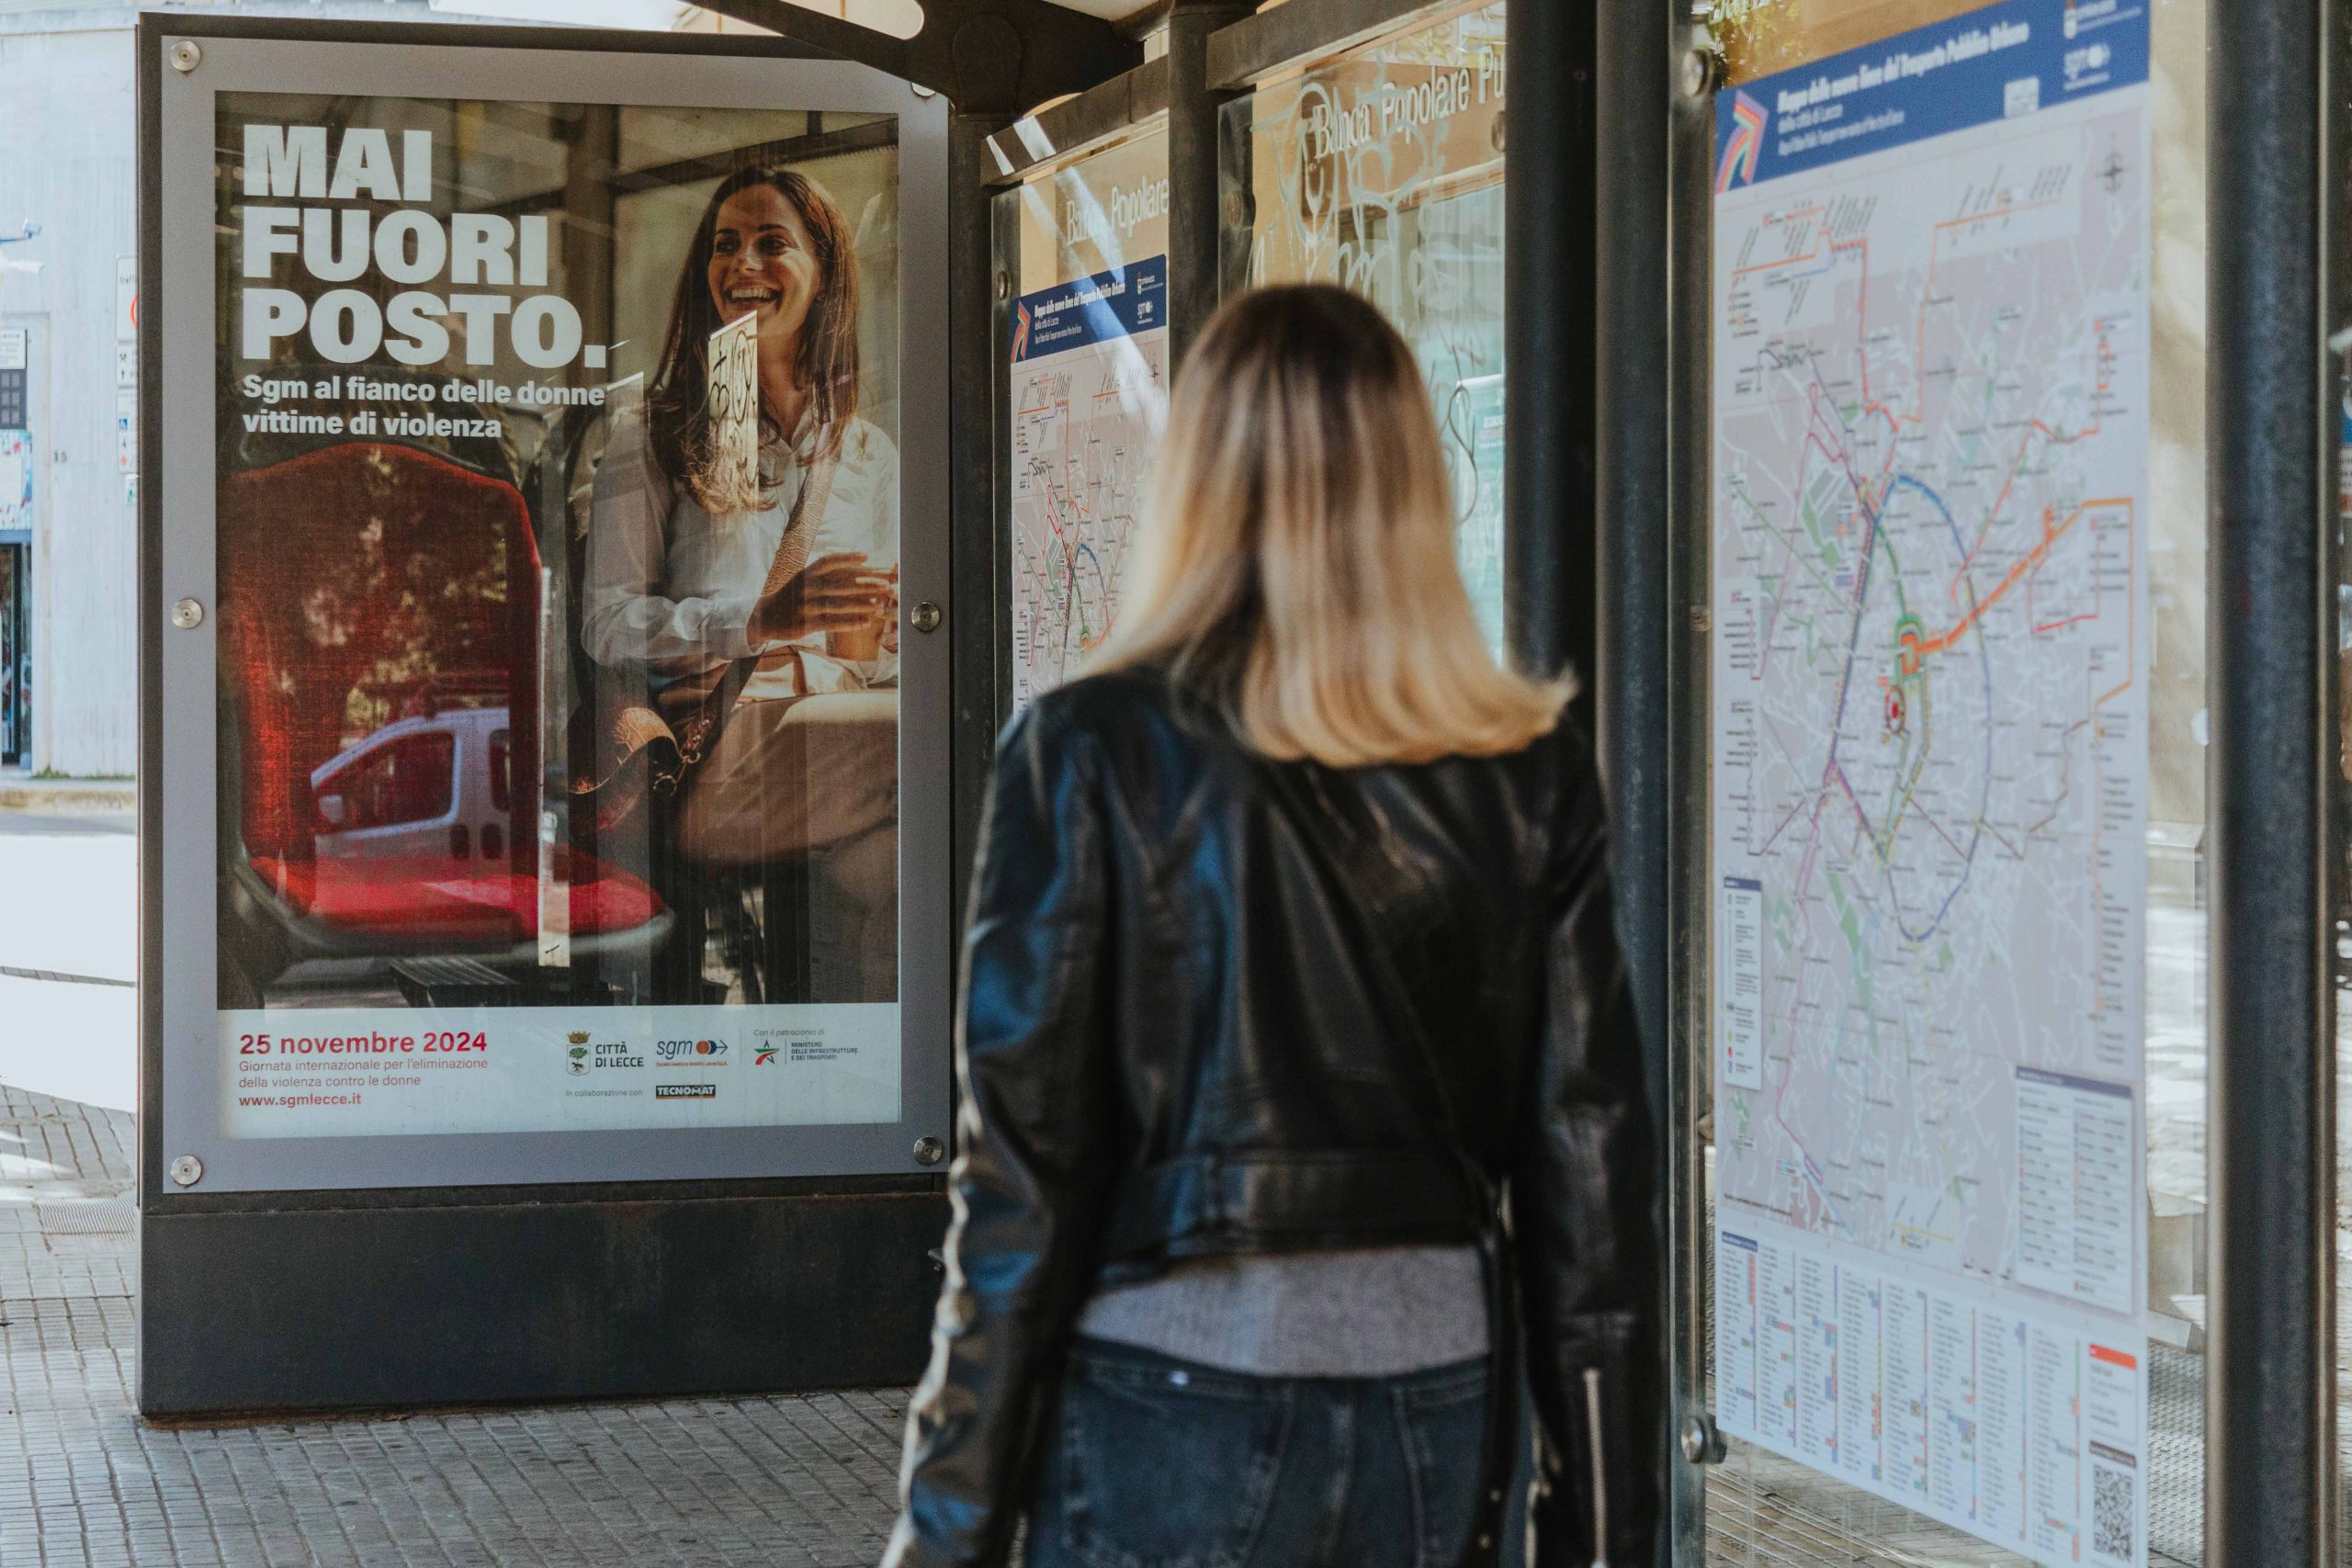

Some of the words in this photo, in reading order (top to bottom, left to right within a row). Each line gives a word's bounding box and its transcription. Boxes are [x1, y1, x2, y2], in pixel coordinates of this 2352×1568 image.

[1313, 103, 1373, 159] Banca
[1381, 65, 1471, 144] Popolare
[243, 124, 432, 201] MAI
[1112, 175, 1170, 238] Popolare
[243, 206, 548, 287] FUORI
[243, 288, 606, 368] POSTO.
[243, 374, 307, 404] Sgm
[314, 376, 340, 400] al
[347, 377, 435, 402] fianco
[442, 378, 512, 404] delle
[517, 380, 605, 405] donne
[243, 411, 343, 434] vittime
[349, 411, 377, 434] di
[383, 412, 502, 437] violenza
[240, 1033, 271, 1055] 25
[280, 1031, 415, 1055] novembre
[423, 1032, 487, 1053] 2024
[753, 1029, 768, 1037] Con
[818, 1028, 825, 1036] di
[595, 1041, 628, 1055] CITTÀ
[656, 1040, 693, 1060] sgm
[239, 1060, 291, 1072] Giornata
[296, 1058, 380, 1071] internazionale
[384, 1061, 403, 1072] per
[407, 1057, 488, 1069] l'eliminazione
[595, 1057, 606, 1067] DI
[610, 1056, 644, 1067] LECCE
[239, 1077, 267, 1088] della
[272, 1076, 322, 1087] violenza
[325, 1077, 365, 1087] contro
[368, 1075, 379, 1086] le
[382, 1075, 421, 1086] donne
[657, 1086, 715, 1096] TECNOMAT
[239, 1092, 362, 1108] www.sgmlecce.it
